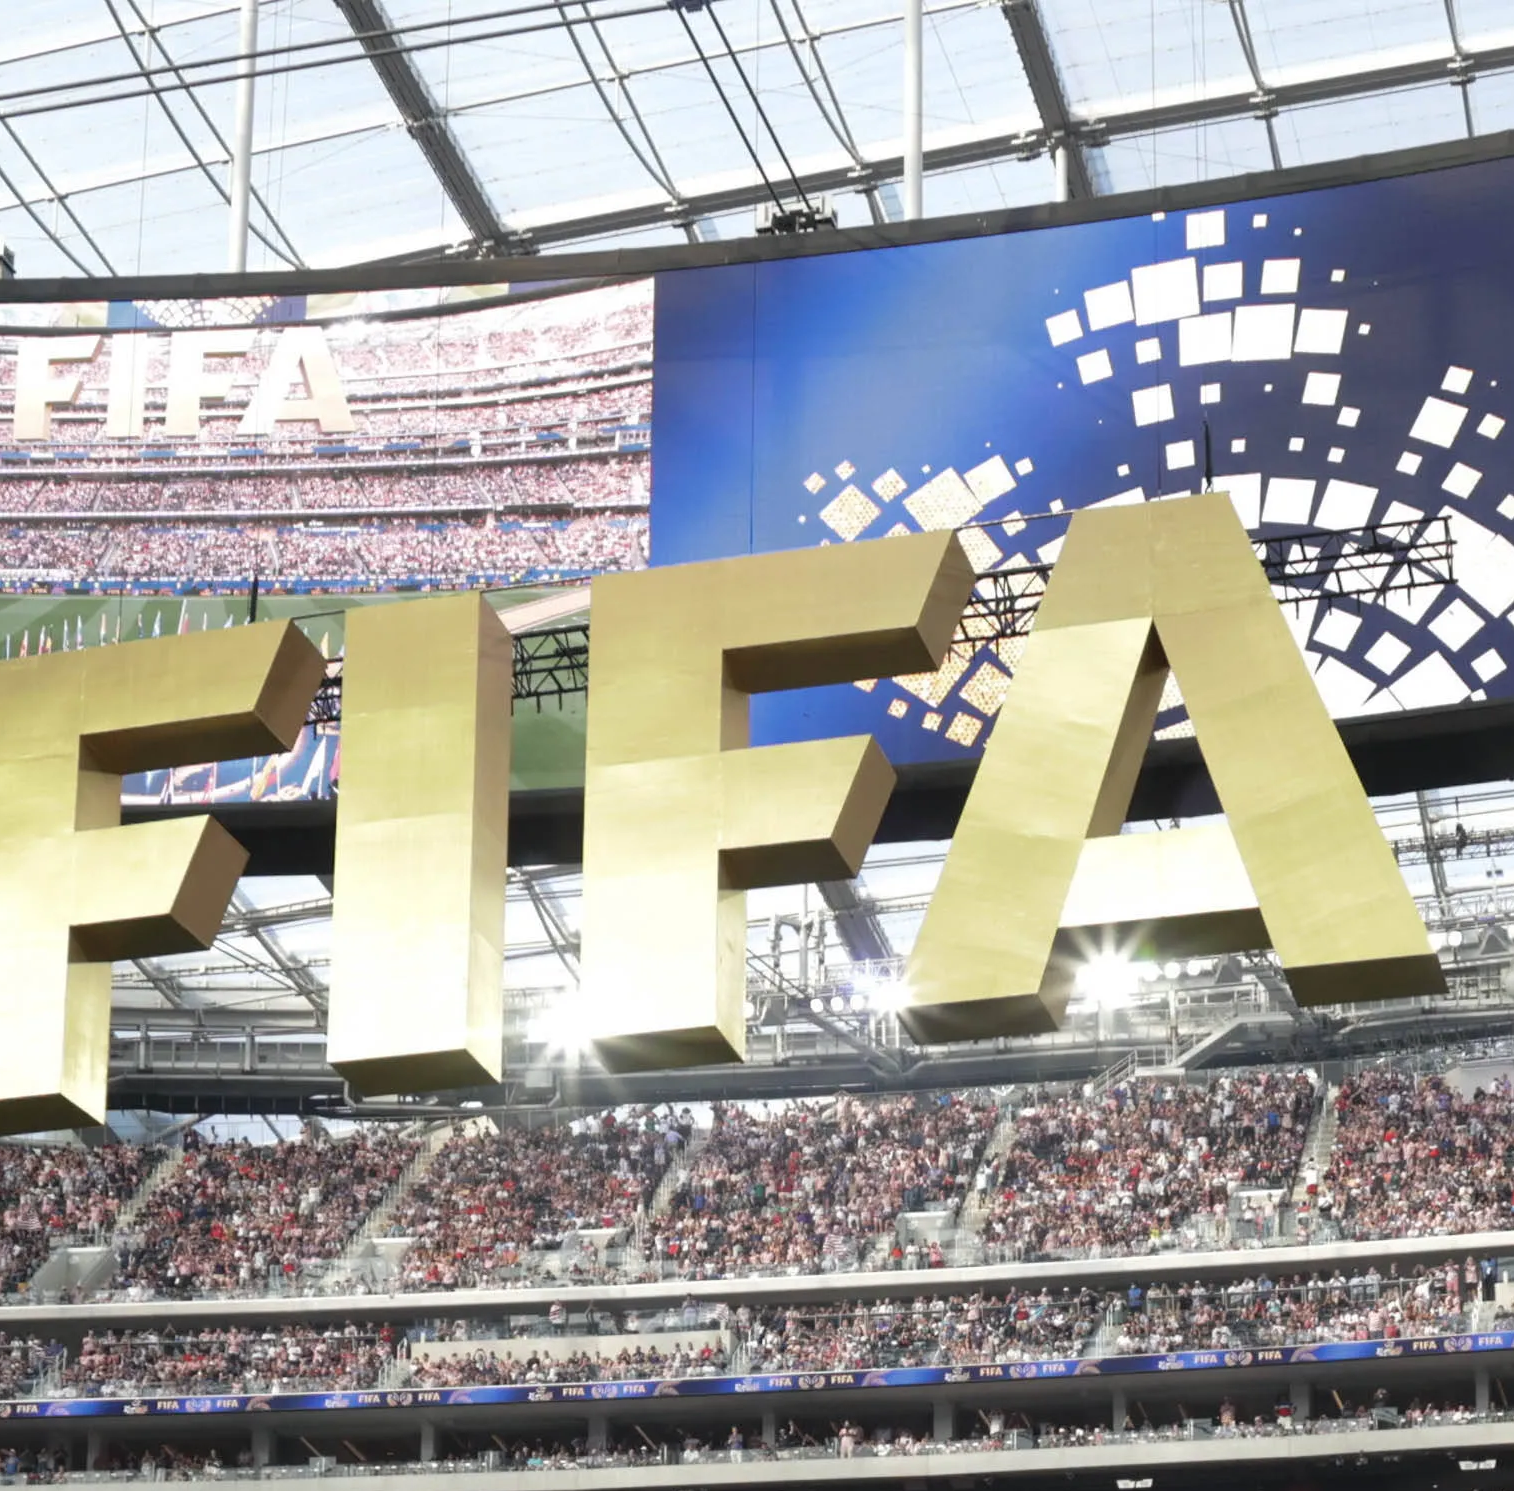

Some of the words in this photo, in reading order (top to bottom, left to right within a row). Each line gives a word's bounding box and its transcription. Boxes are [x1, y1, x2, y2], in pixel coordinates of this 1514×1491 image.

[13, 326, 357, 441] FIFA
[1413, 1340, 1437, 1350] FIFA
[1478, 1336, 1503, 1346] FIFA
[1194, 1354, 1218, 1364] FIFA
[1258, 1350, 1282, 1360] FIFA
[980, 1367, 1003, 1376] FIFA
[1042, 1363, 1066, 1373] FIFA
[769, 1377, 792, 1387] FIFA
[831, 1374, 854, 1384] FIFA
[563, 1387, 585, 1396] FIFA
[623, 1384, 645, 1394] FIFA
[358, 1394, 380, 1403] FIFA
[418, 1392, 440, 1401] FIFA
[17, 1404, 38, 1413] FIFA
[157, 1400, 179, 1410] FIFA
[216, 1399, 238, 1408] FIFA
